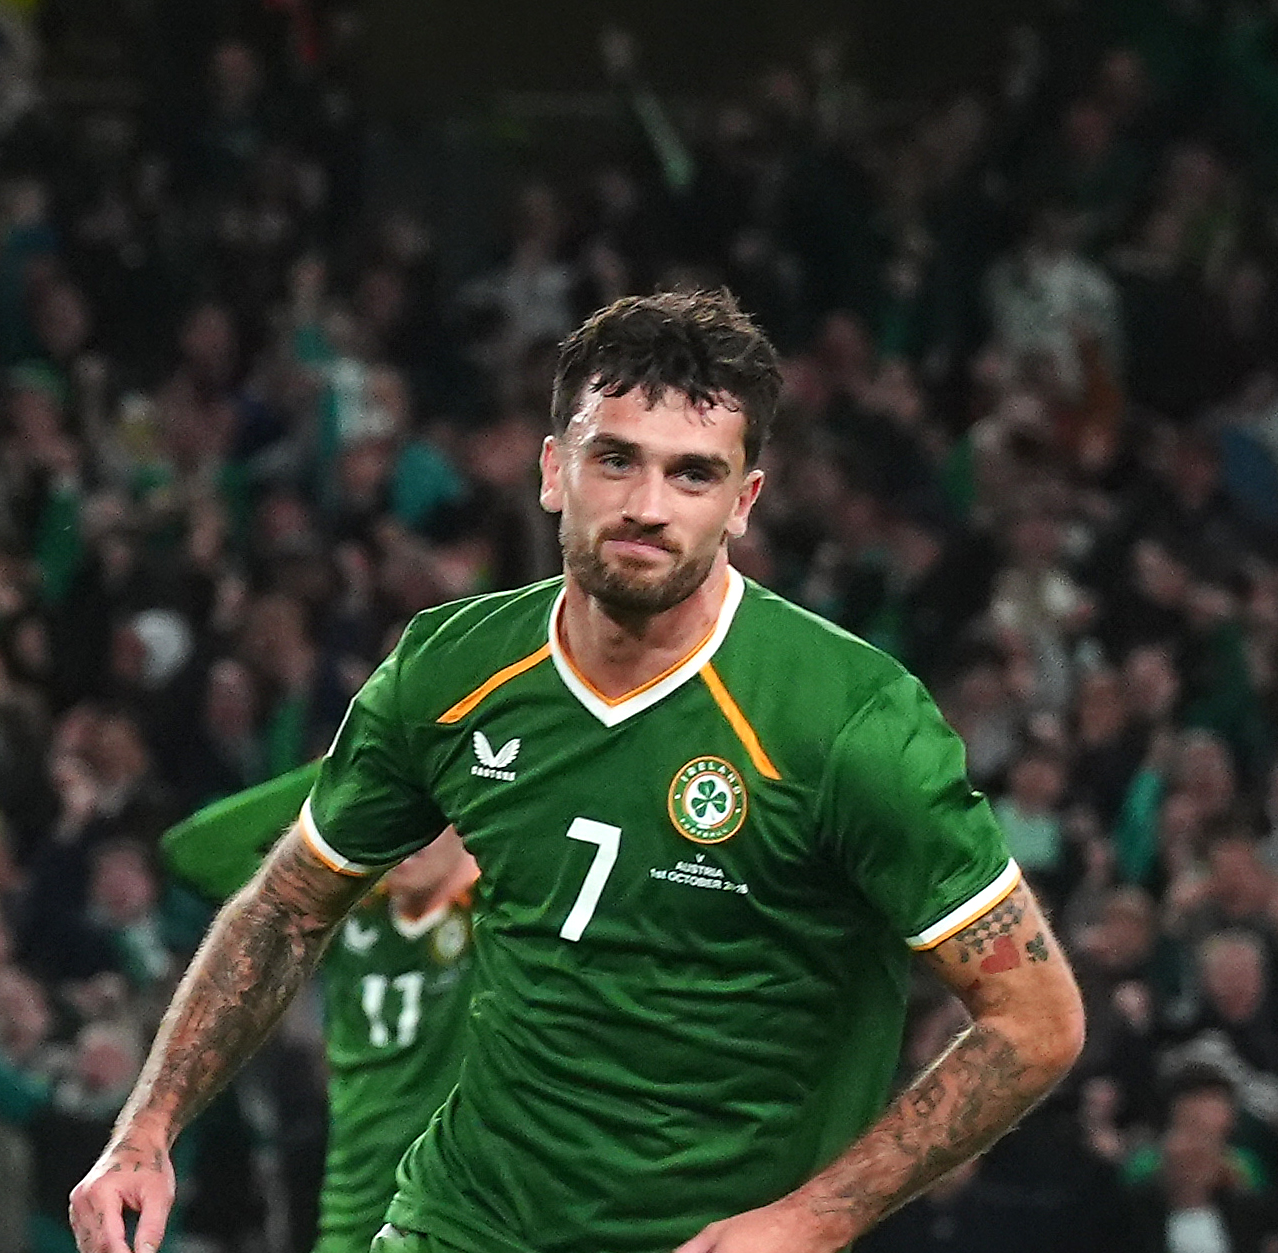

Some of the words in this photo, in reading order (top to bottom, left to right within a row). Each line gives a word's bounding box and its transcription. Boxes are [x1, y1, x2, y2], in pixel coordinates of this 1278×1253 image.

[559, 816, 622, 942] 7
[667, 871, 723, 890] OCTOBER
[675, 861, 725, 879] AUSTRIA
[361, 972, 424, 1048] 11
